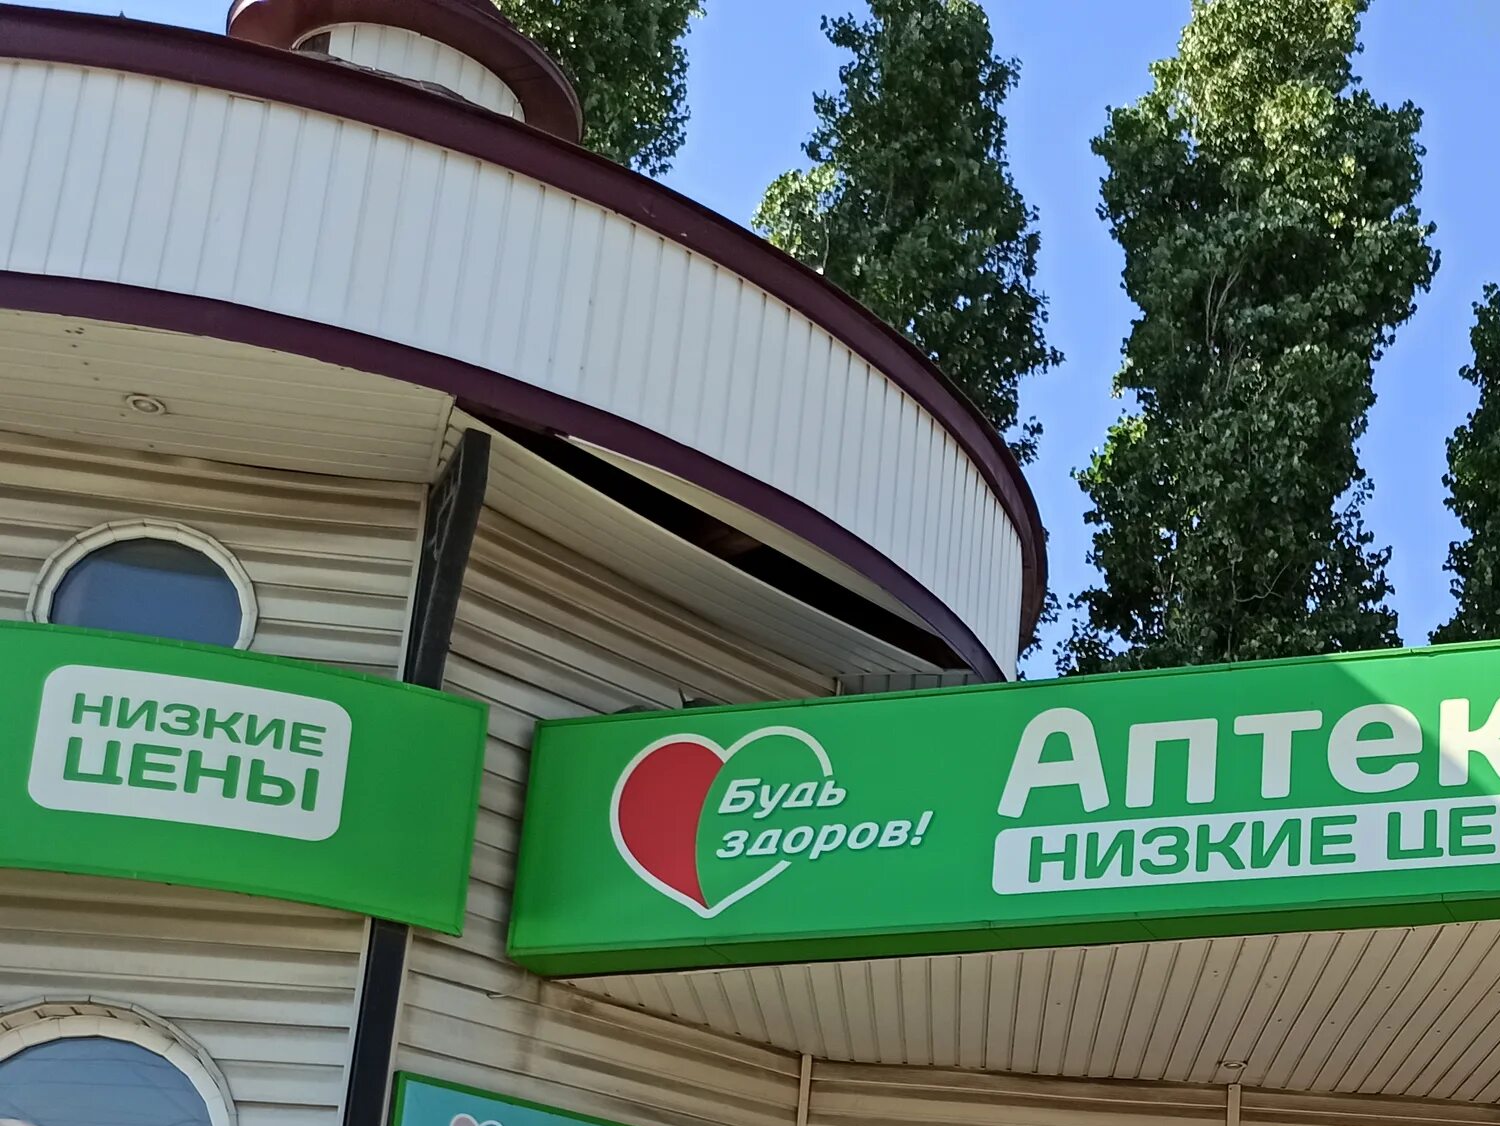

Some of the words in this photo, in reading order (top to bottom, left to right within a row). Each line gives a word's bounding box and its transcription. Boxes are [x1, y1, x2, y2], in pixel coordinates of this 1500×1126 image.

[72, 692, 327, 758] НИЗКИЕ
[62, 736, 320, 812] ЦЕНЫ
[717, 777, 848, 819] Будь
[715, 810, 935, 860] здоров!
[1027, 814, 1358, 884] НИЗКИЕ
